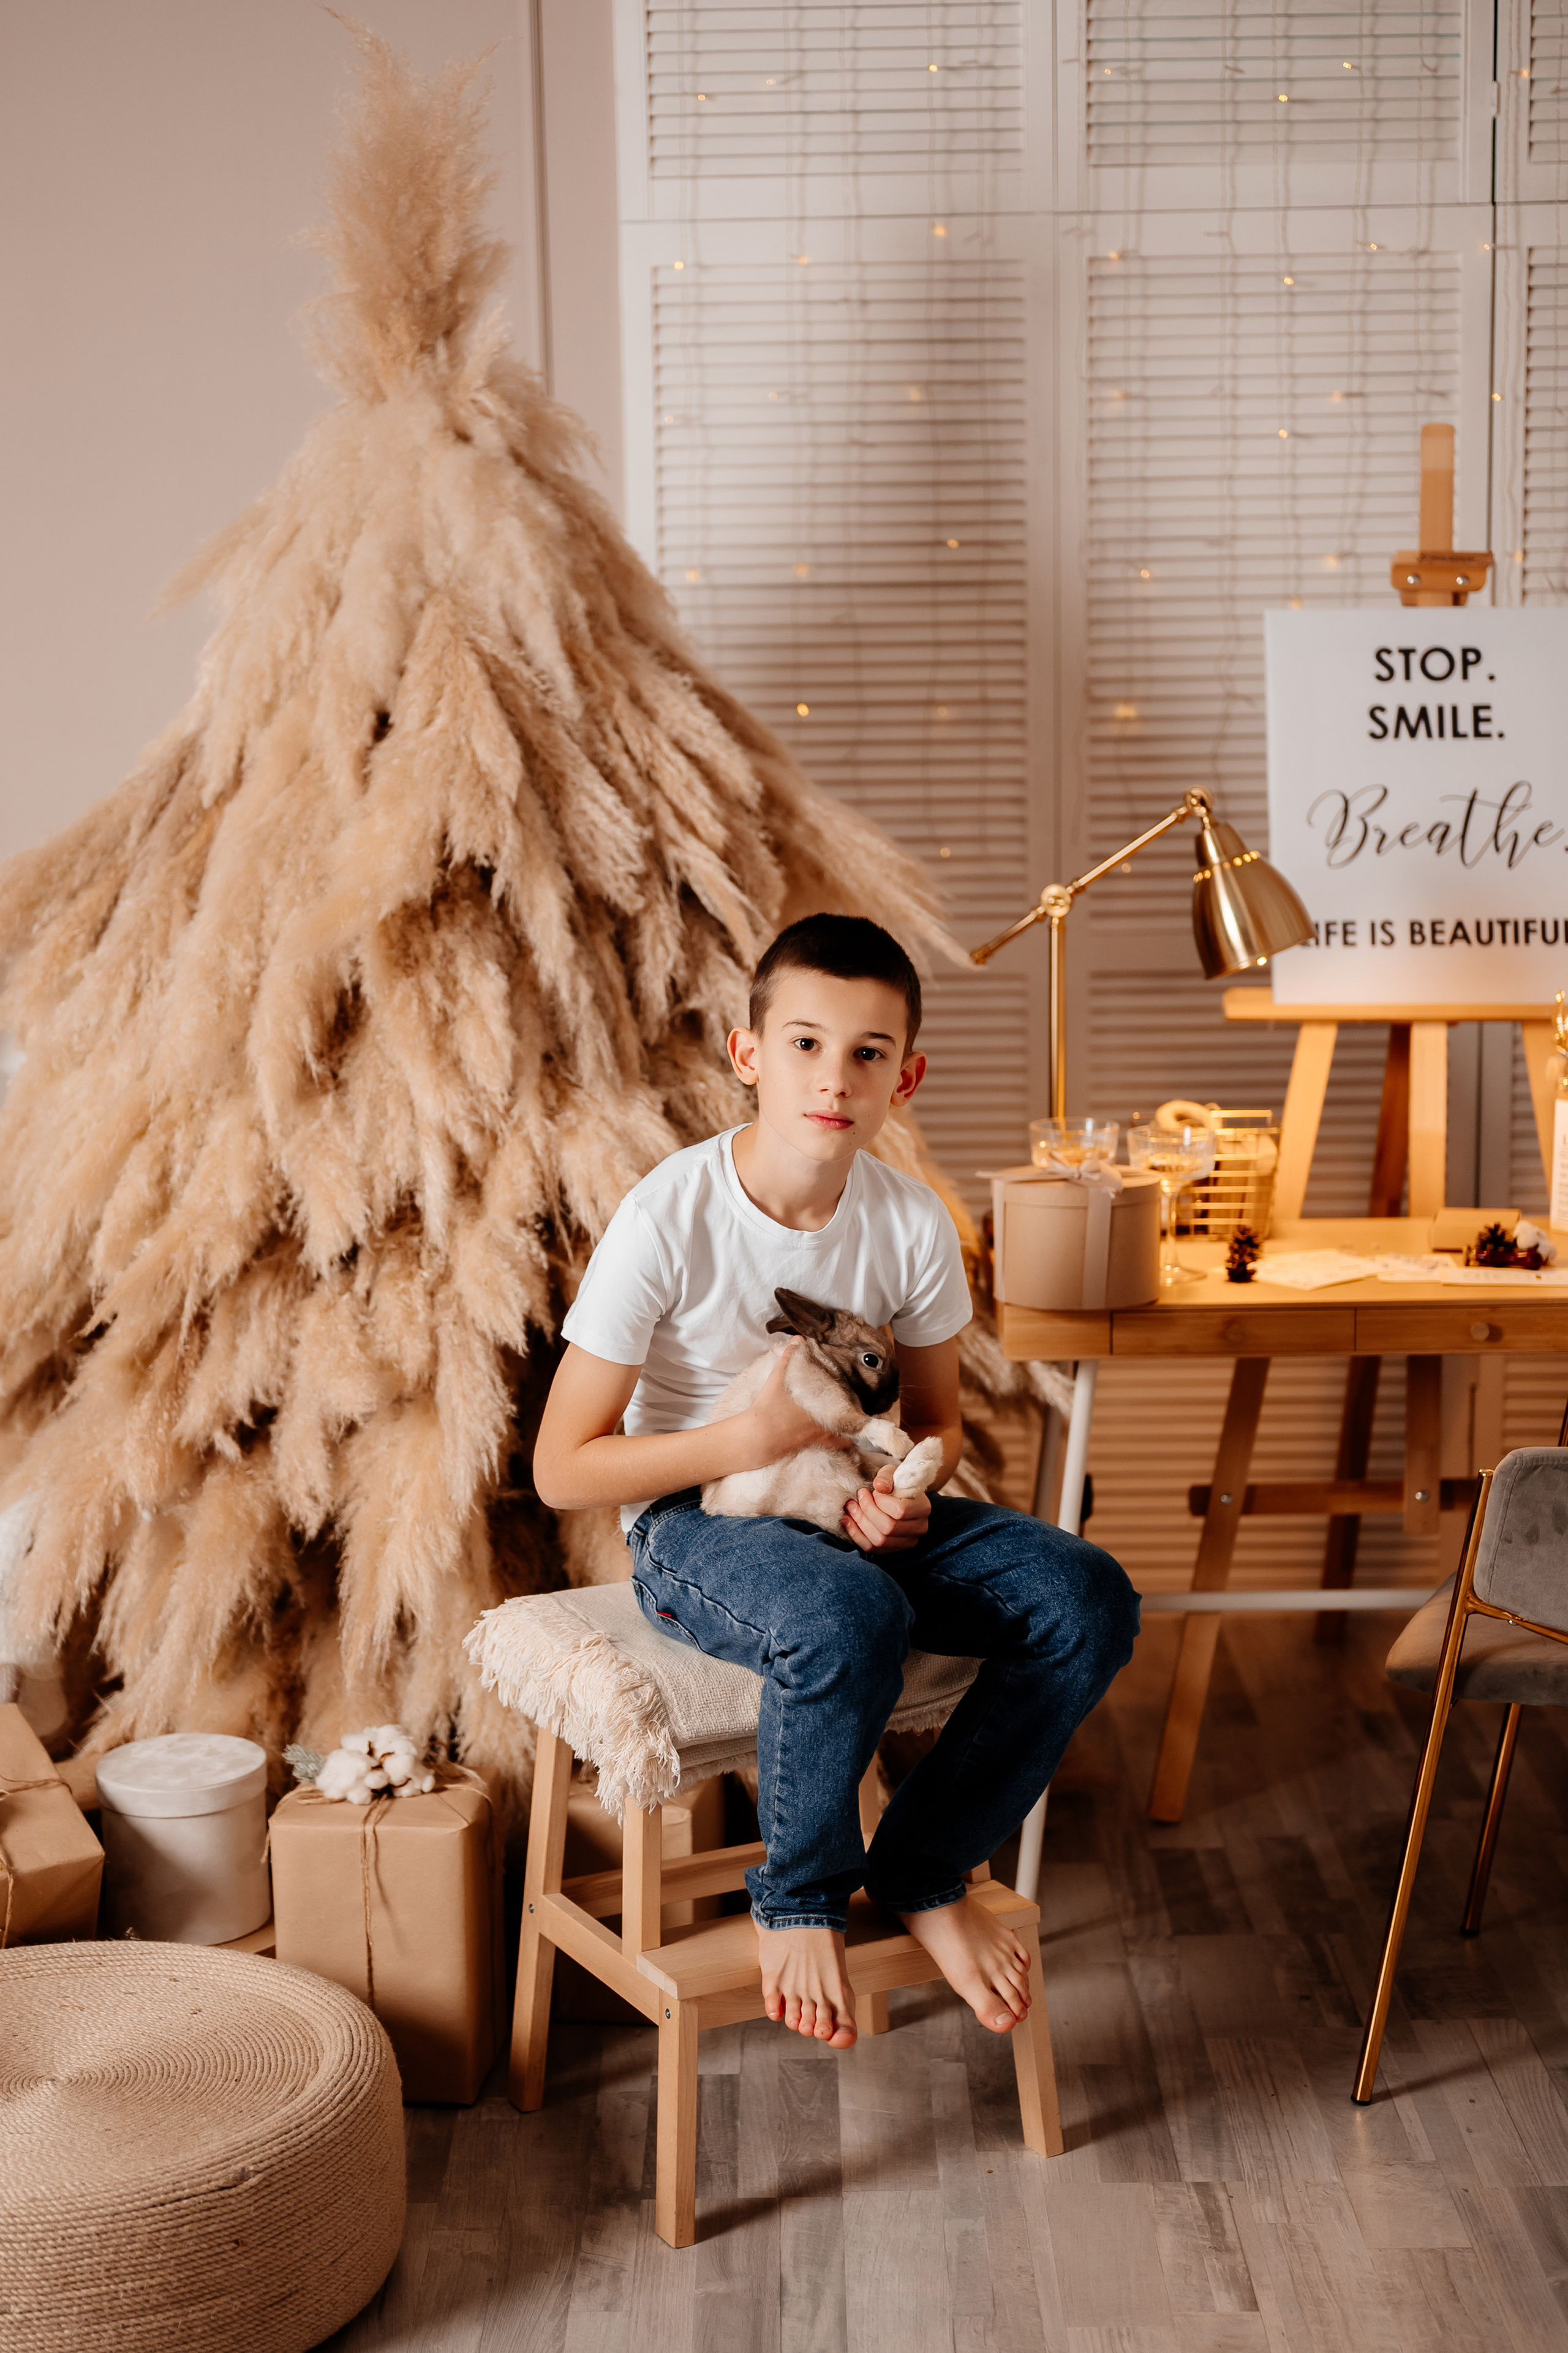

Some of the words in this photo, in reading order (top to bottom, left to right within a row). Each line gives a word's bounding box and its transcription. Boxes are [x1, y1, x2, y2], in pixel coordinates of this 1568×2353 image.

[1374, 647, 1496, 682] STOP.
[1368, 704, 1506, 739] SMILE.
[1301, 920, 1357, 947] IFE
[1370, 920, 1395, 947] IS
